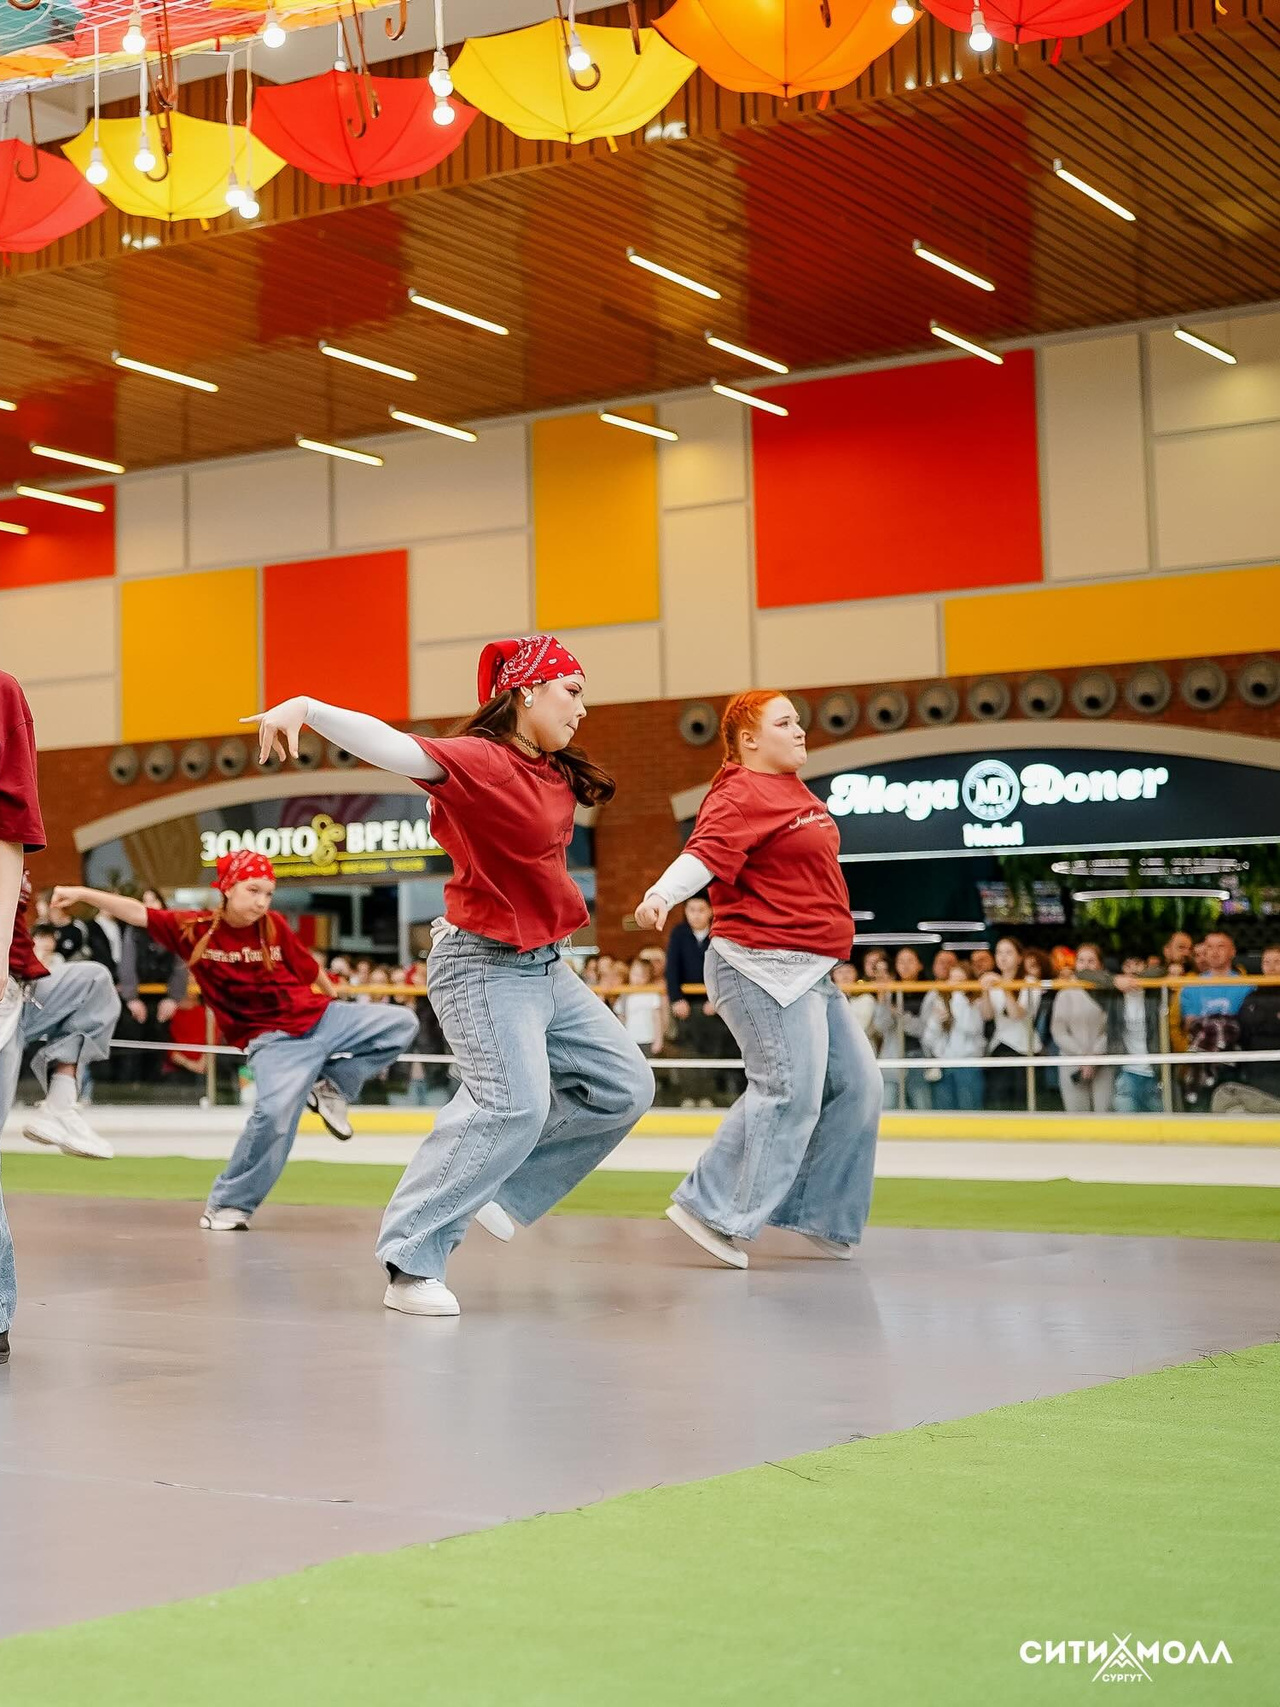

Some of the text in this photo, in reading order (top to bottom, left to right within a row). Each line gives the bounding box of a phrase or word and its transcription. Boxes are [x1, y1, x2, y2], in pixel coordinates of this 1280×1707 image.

[827, 774, 959, 821] Mega
[1020, 763, 1168, 805] Doner
[201, 826, 319, 861] ЗОЛОТО
